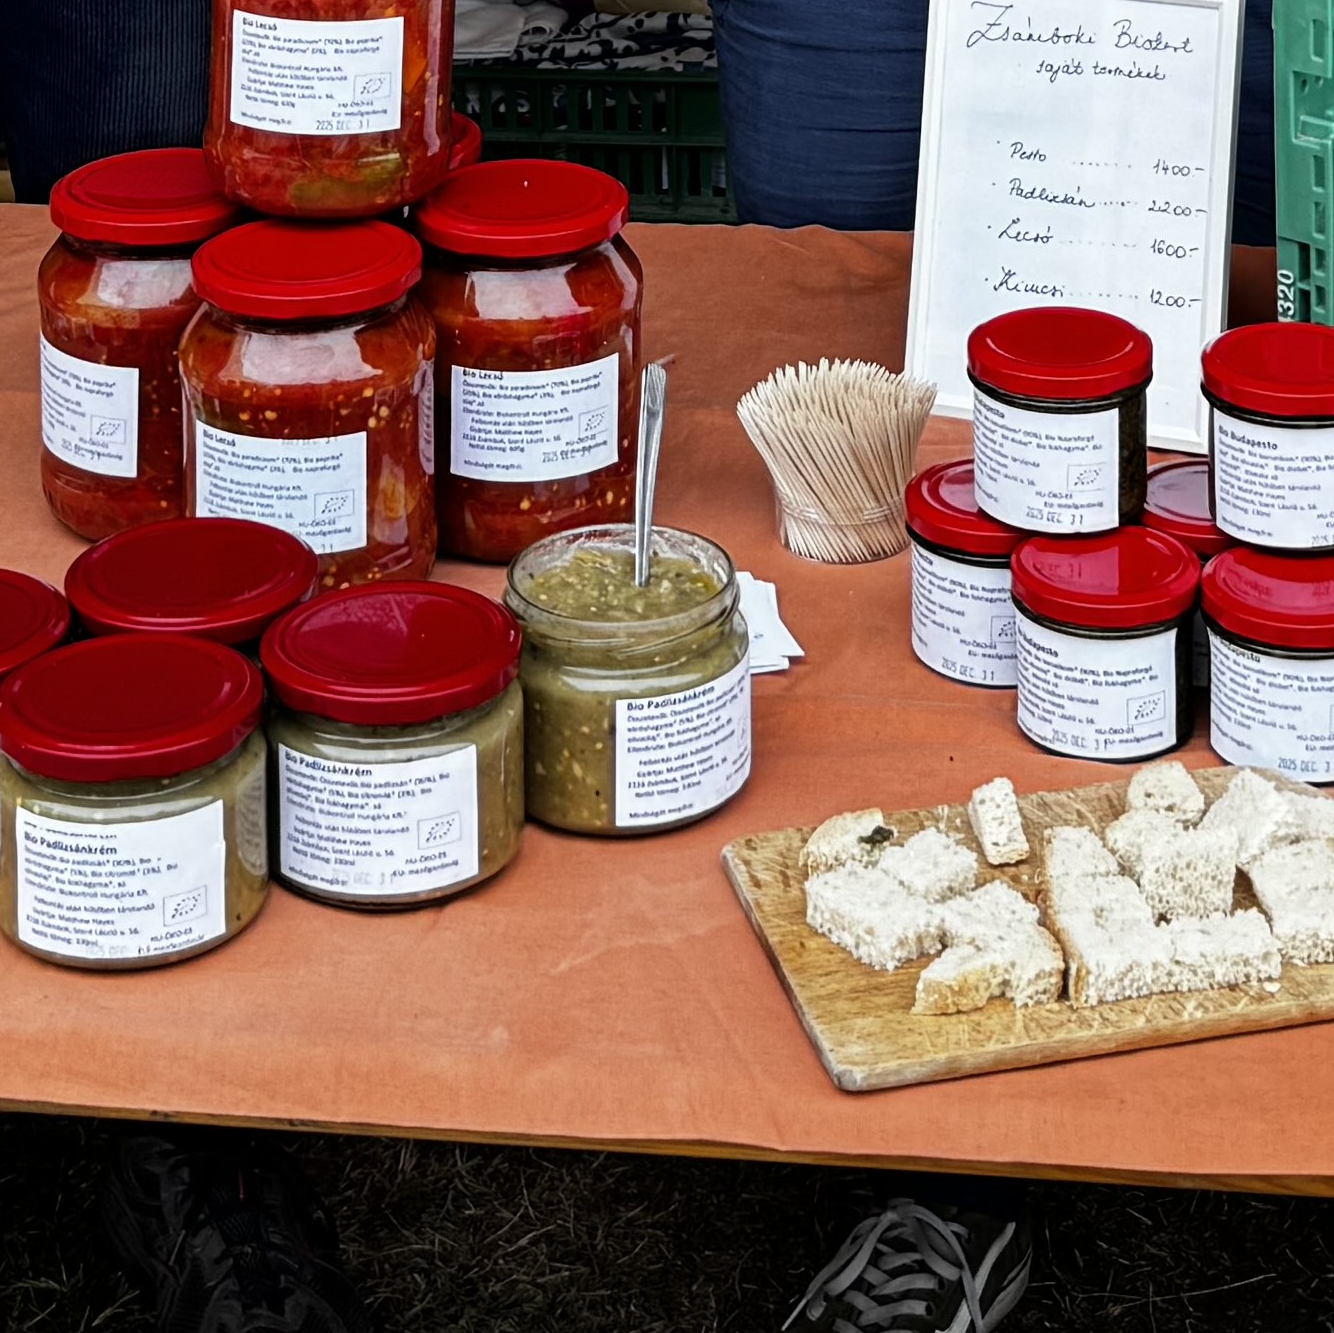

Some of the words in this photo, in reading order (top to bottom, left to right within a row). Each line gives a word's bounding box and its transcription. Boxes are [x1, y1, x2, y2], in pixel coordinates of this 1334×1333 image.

[966, 1, 1096, 48] Zsámboki
[1010, 141, 1047, 162] Pesto
[998, 217, 1053, 243] Lecsó
[463, 369, 476, 378] Bio
[203, 429, 214, 440] Bio
[215, 433, 236, 447] Lecsó
[1230, 431, 1278, 451] Budapesto
[627, 702, 644, 711] Bio
[285, 752, 298, 764] Bio
[299, 757, 372, 777] Padlizsánkrém
[1277, 758, 1297, 771] 2025
[24, 831, 38, 845] Bio
[40, 836, 117, 855] Padlizsánkrém
